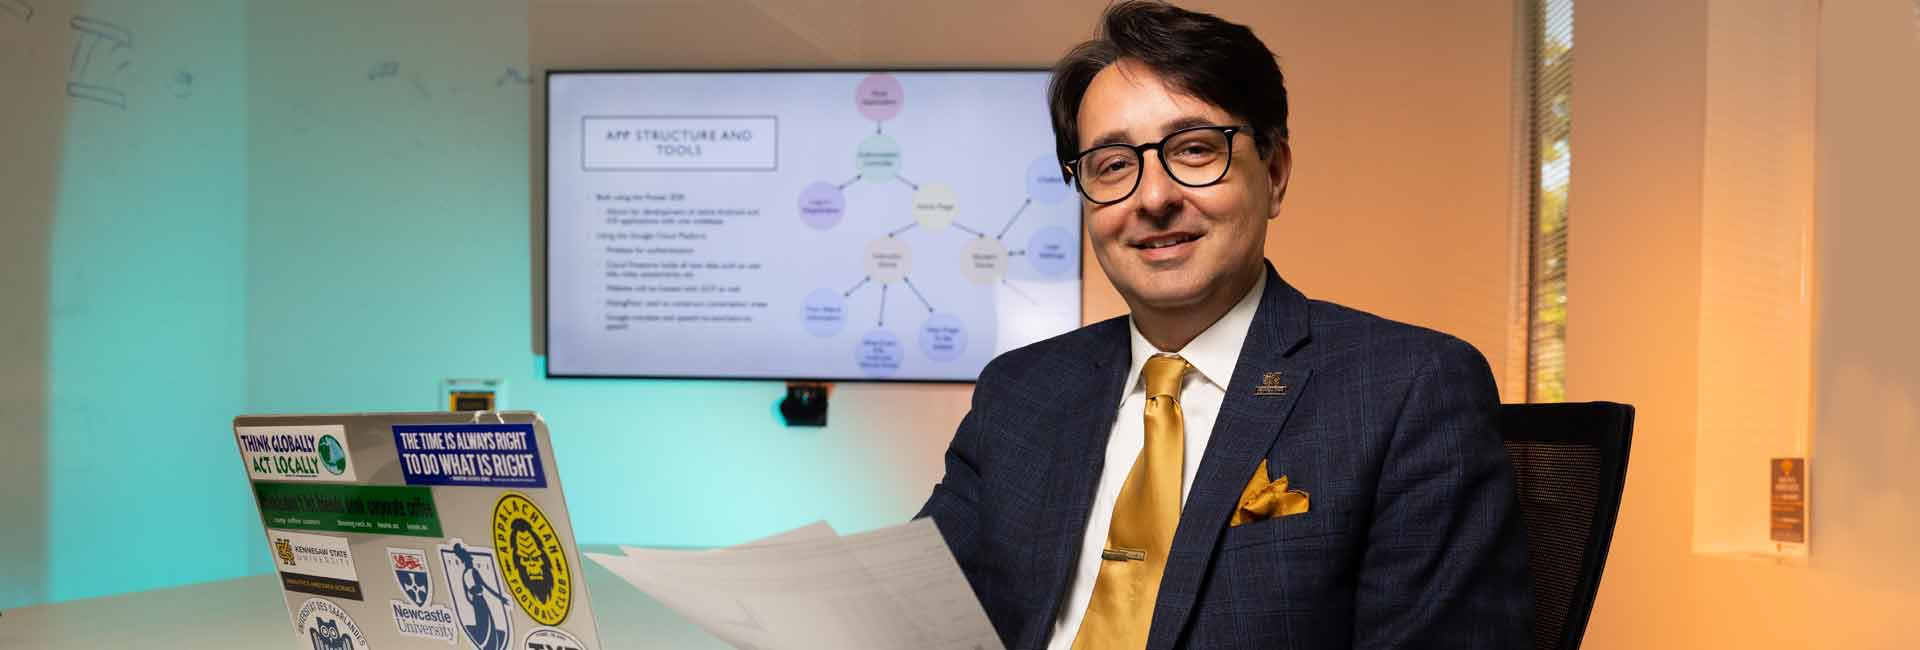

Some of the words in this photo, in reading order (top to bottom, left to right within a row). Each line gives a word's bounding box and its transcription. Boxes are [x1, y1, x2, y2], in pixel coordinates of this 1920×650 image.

[607, 129, 632, 141] APP
[635, 129, 717, 142] STRUCTURE
[720, 129, 754, 142] AND
[656, 144, 702, 156] TOOLS
[241, 434, 270, 453] THINK
[271, 434, 316, 453] GLOBALLY
[400, 432, 420, 450] THE
[419, 432, 445, 450] TIME
[444, 432, 456, 450] IS
[456, 432, 495, 450] ALWAYS
[494, 432, 527, 450] RIGHT
[253, 456, 272, 474] ACT
[273, 456, 320, 474] LOCALLY
[403, 454, 421, 475] TO
[420, 454, 439, 475] DO
[438, 454, 477, 476] WHAT
[476, 454, 493, 477] IS
[493, 454, 535, 477] RIGHT
[497, 500, 559, 554] APPALACHIAN
[294, 545, 329, 556] KENNESAW
[328, 549, 348, 559] STATE
[510, 577, 559, 621] FOOTBALL
[393, 604, 452, 623] Newcastle
[397, 619, 454, 640] University
